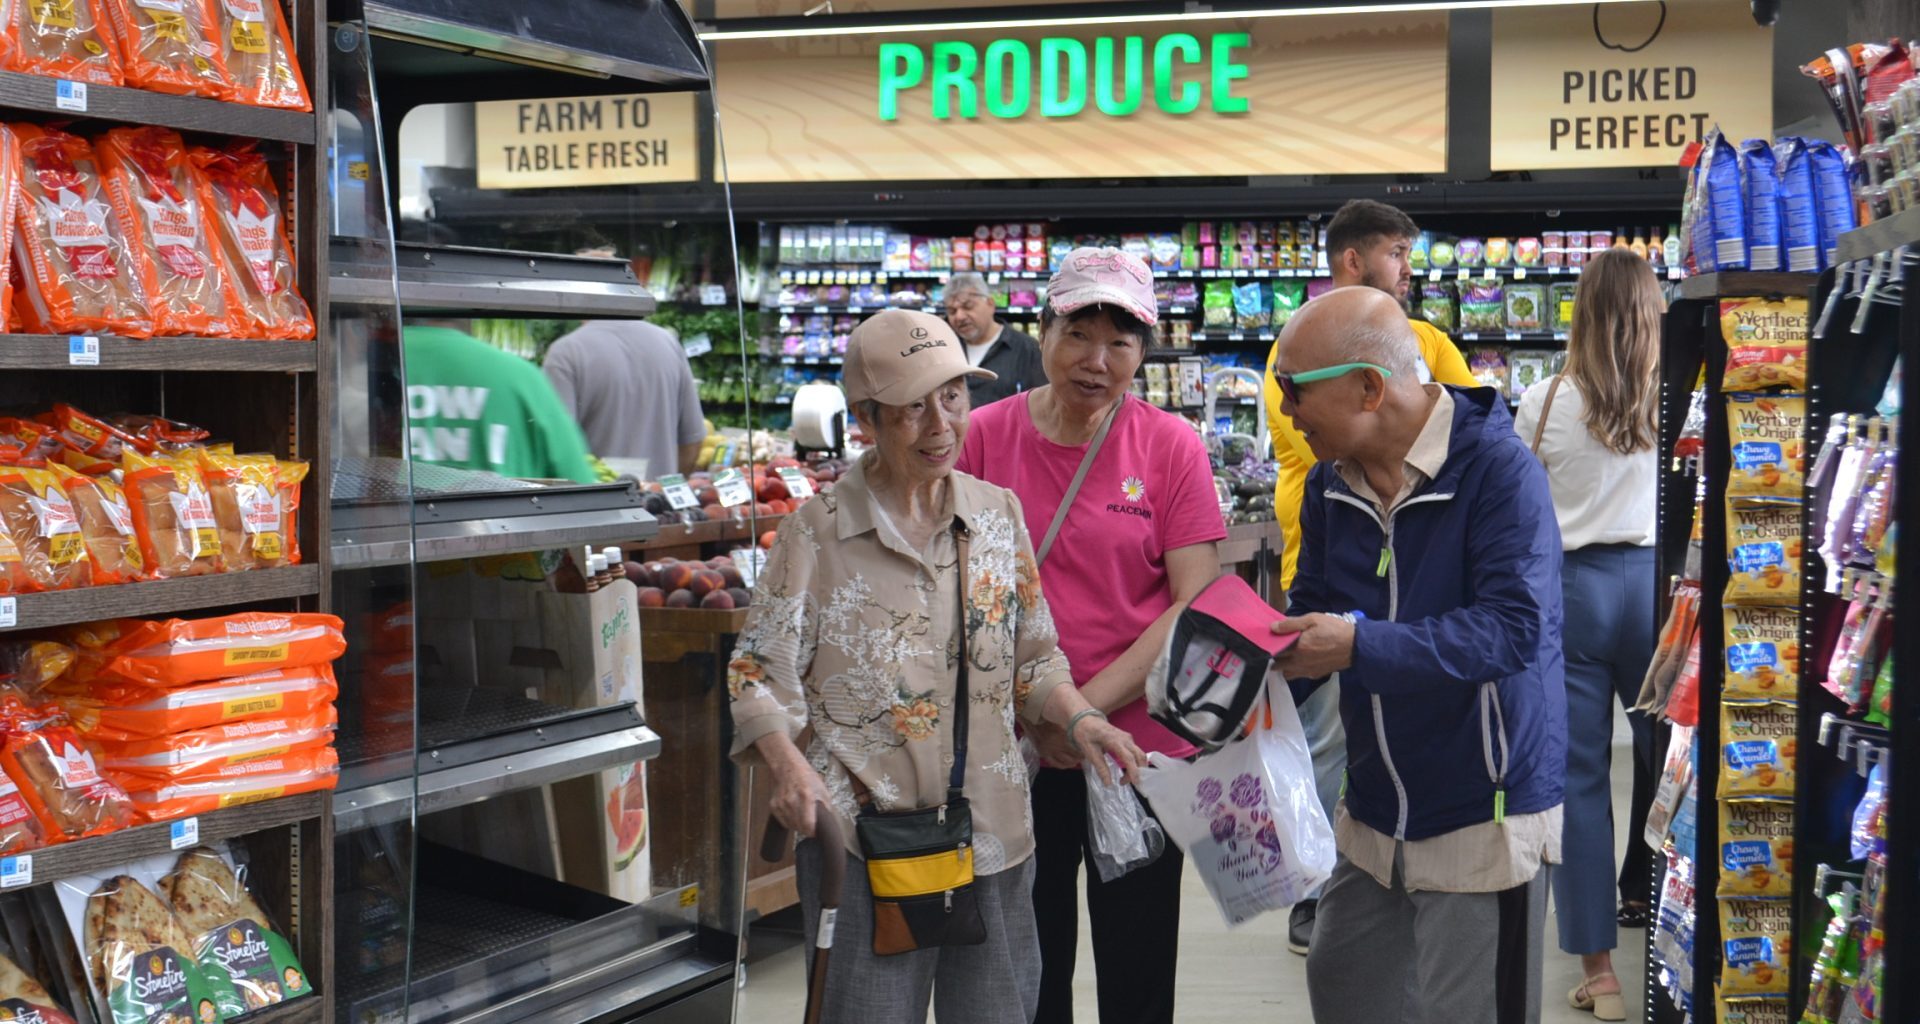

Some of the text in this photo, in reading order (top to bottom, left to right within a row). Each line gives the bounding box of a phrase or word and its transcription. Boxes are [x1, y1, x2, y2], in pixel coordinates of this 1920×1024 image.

[879, 33, 1250, 121] PRODUCE
[1563, 66, 1697, 104] PICKED
[518, 97, 650, 134] FARM TO
[1550, 113, 1709, 151] PERFECT
[504, 139, 669, 172] TABLE FRESH
[1755, 326, 1808, 344] Origina
[900, 340, 948, 357] LEXUS
[406, 385, 490, 420] OW
[1757, 426, 1800, 442] Origin
[404, 426, 472, 462] AN
[1738, 509, 1801, 526] Werther
[1756, 524, 1800, 541] Origin
[1733, 608, 1799, 626] Werther
[1752, 625, 1796, 642] Origin
[1732, 708, 1797, 724] Werther
[1750, 721, 1796, 739] Origin
[1728, 804, 1793, 822] Werther
[1745, 821, 1794, 840] Origin
[1217, 844, 1257, 872] Thank
[1233, 867, 1259, 882] You
[1728, 901, 1791, 918] Werther
[1746, 918, 1790, 936] Origin
[213, 929, 270, 966] Stonefire
[134, 958, 187, 998] Stonefire
[1727, 1001, 1787, 1014] Werther
[1743, 1011, 1787, 1024] Origin
